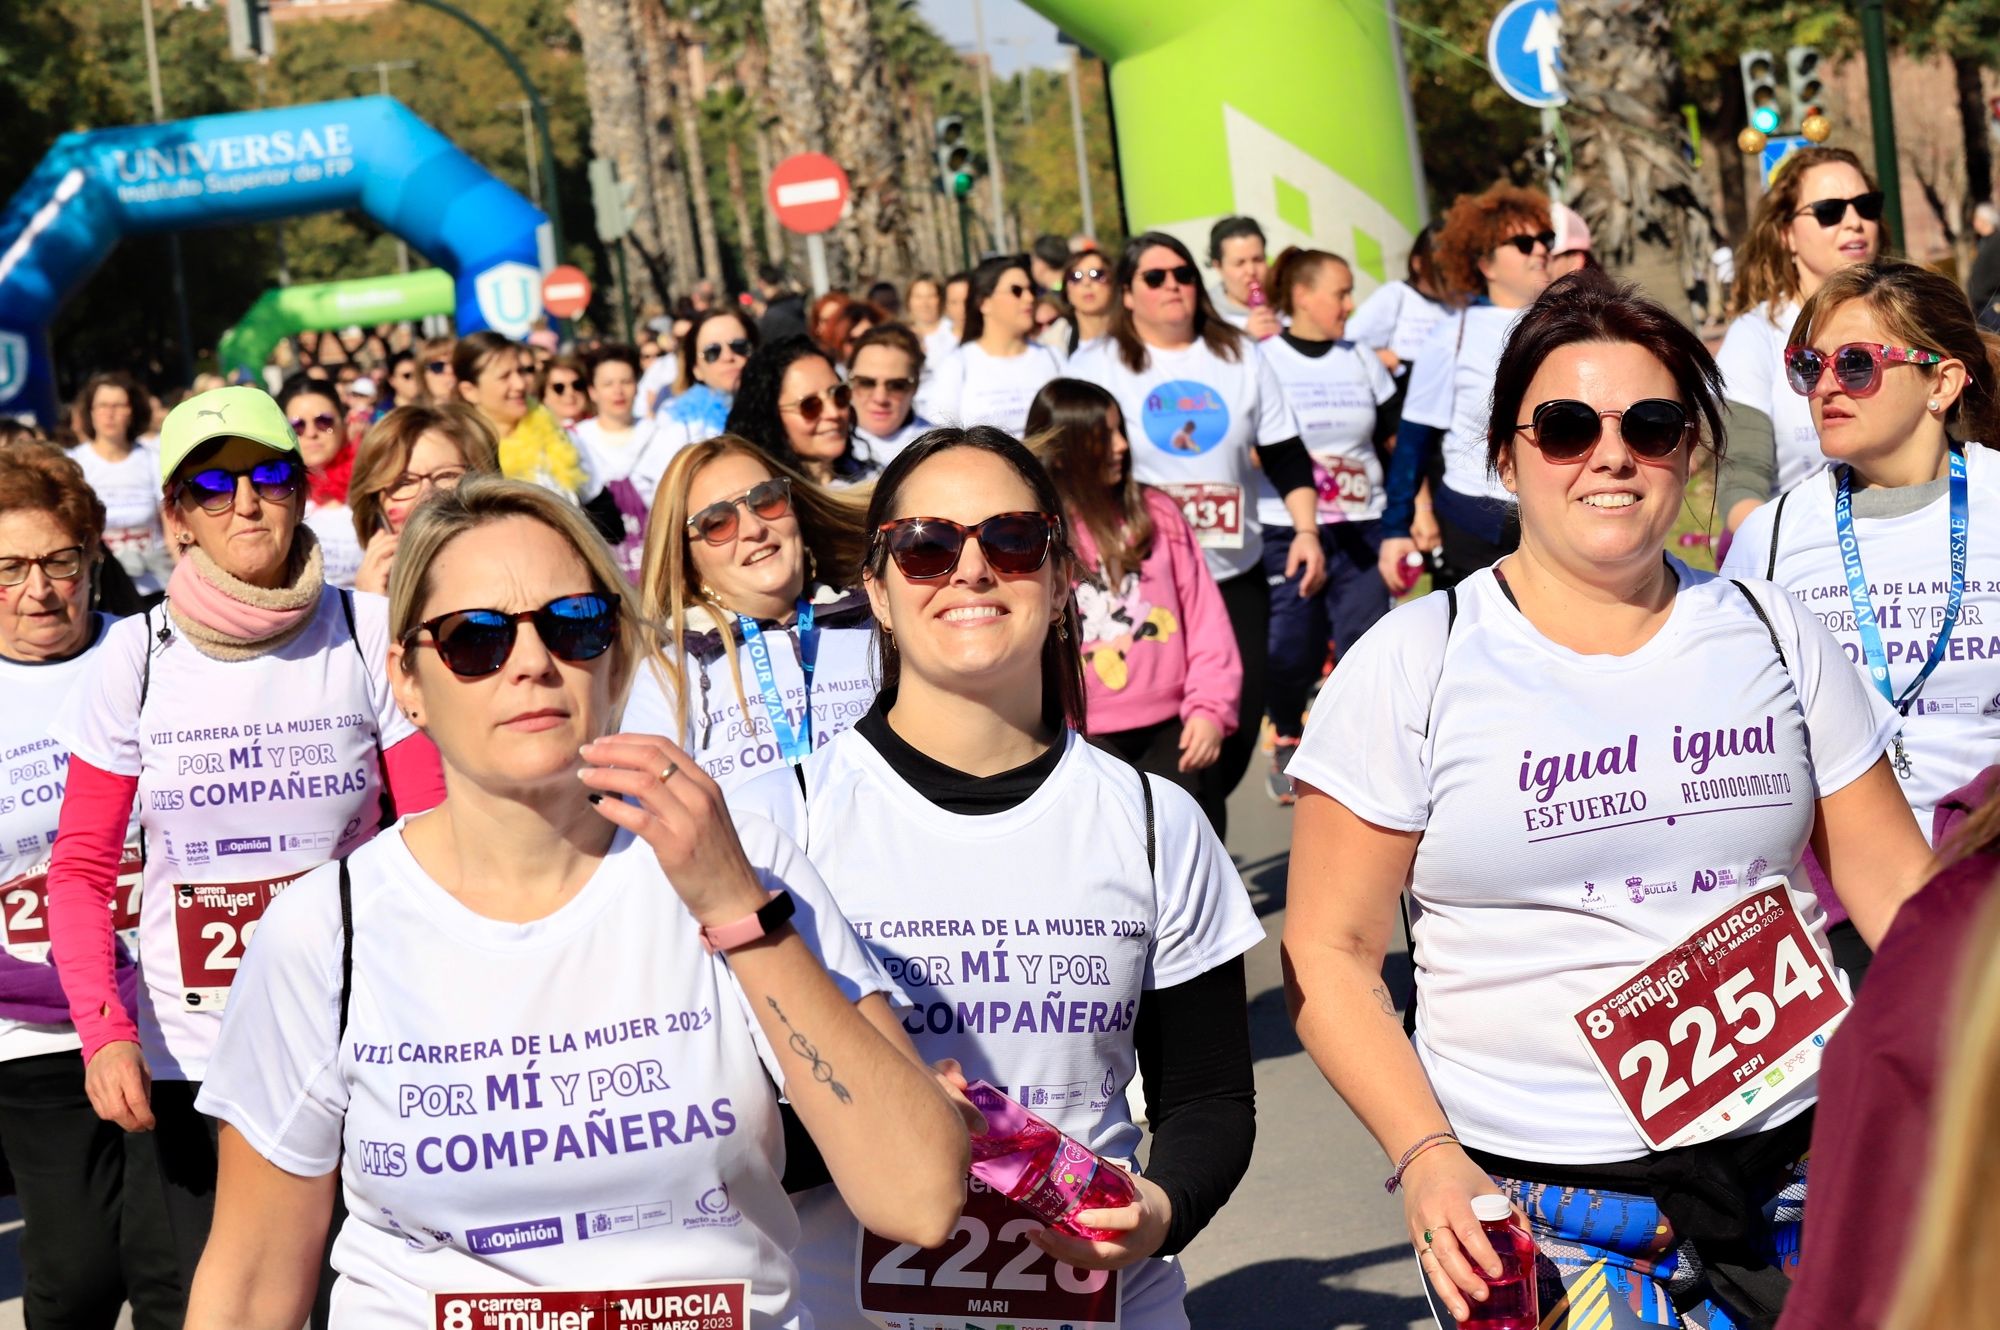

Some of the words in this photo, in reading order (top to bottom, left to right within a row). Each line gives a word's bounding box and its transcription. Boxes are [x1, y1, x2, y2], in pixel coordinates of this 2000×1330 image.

[115, 123, 352, 182] UNIVERSAE
[117, 178, 203, 203] Instituto
[205, 169, 289, 193] Superior
[293, 162, 323, 182] de
[324, 156, 353, 178] FP
[1839, 527, 1861, 579] YOUR
[1852, 584, 1875, 626] WAY
[1946, 519, 1966, 620] UNIVERSAE
[1812, 584, 1878, 599] CARRA
[1884, 583, 1903, 595] DE
[1908, 583, 1926, 594] LA
[1932, 581, 1980, 593] MUER
[1908, 607, 1927, 628] Y
[748, 634, 772, 683] YOUR
[764, 688, 787, 724] WAY
[828, 680, 870, 692] MUJER
[150, 732, 173, 745] VIII
[177, 726, 239, 743] CARRERA
[244, 724, 261, 736] DE
[267, 722, 283, 734] LA
[288, 718, 332, 733] MUJER
[337, 714, 364, 728] 2023
[728, 717, 772, 741] POR
[813, 704, 828, 721] Y
[10, 759, 50, 785] POR
[178, 753, 224, 775] POR
[230, 739, 263, 769] MÍ
[268, 748, 284, 767] Y
[290, 743, 336, 766] POR
[1519, 735, 1638, 803] igual
[1673, 716, 1775, 775] igual
[151, 790, 184, 810] MIS
[189, 768, 367, 807] COMPAÑERAS
[1524, 790, 1647, 831] ESFUERZO
[1681, 773, 1791, 803] RECONOCIMIENTO
[194, 886, 226, 894] carrera
[204, 892, 256, 916] mujer
[1645, 885, 1678, 895] BULLAS
[880, 920, 975, 938] CARRERA
[982, 919, 1008, 936] DE
[1015, 919, 1040, 936] LA
[1046, 919, 1106, 937] MUJER
[1112, 920, 1146, 937] 2023
[1700, 896, 1779, 956] MURCIA
[1707, 957, 1715, 966] 5
[1715, 948, 1728, 960] DE
[1728, 924, 1761, 950] MARZO
[1761, 908, 1785, 926] 2023
[884, 955, 953, 985] POR
[961, 939, 1009, 983] MÍ
[1017, 955, 1042, 984] Y
[1050, 955, 1110, 985] POR
[1608, 975, 1652, 1009] carrera
[1627, 960, 1690, 1018] mujer
[902, 990, 1135, 1034] COMPAÑERAS
[1618, 934, 1823, 1121] 2254
[353, 1042, 393, 1064] VIII
[398, 1039, 504, 1064] CARRERA
[511, 1036, 541, 1055] DE
[549, 1033, 577, 1053] LA
[584, 1018, 659, 1050] MUJER
[665, 1007, 712, 1034] 2023
[1733, 1053, 1765, 1082] PEPI
[399, 1084, 477, 1118] POR
[486, 1060, 543, 1111] MÍ
[551, 1074, 580, 1106] Y
[588, 1060, 670, 1102] POR
[360, 1140, 407, 1177] MIS
[416, 1097, 737, 1175] COMPAÑERAS
[478, 1298, 541, 1312] carrera
[620, 1293, 730, 1321] MURCIA
[652, 1319, 699, 1330] MARZO
[702, 1317, 733, 1330] 2023
[967, 1299, 1009, 1312] MARI
